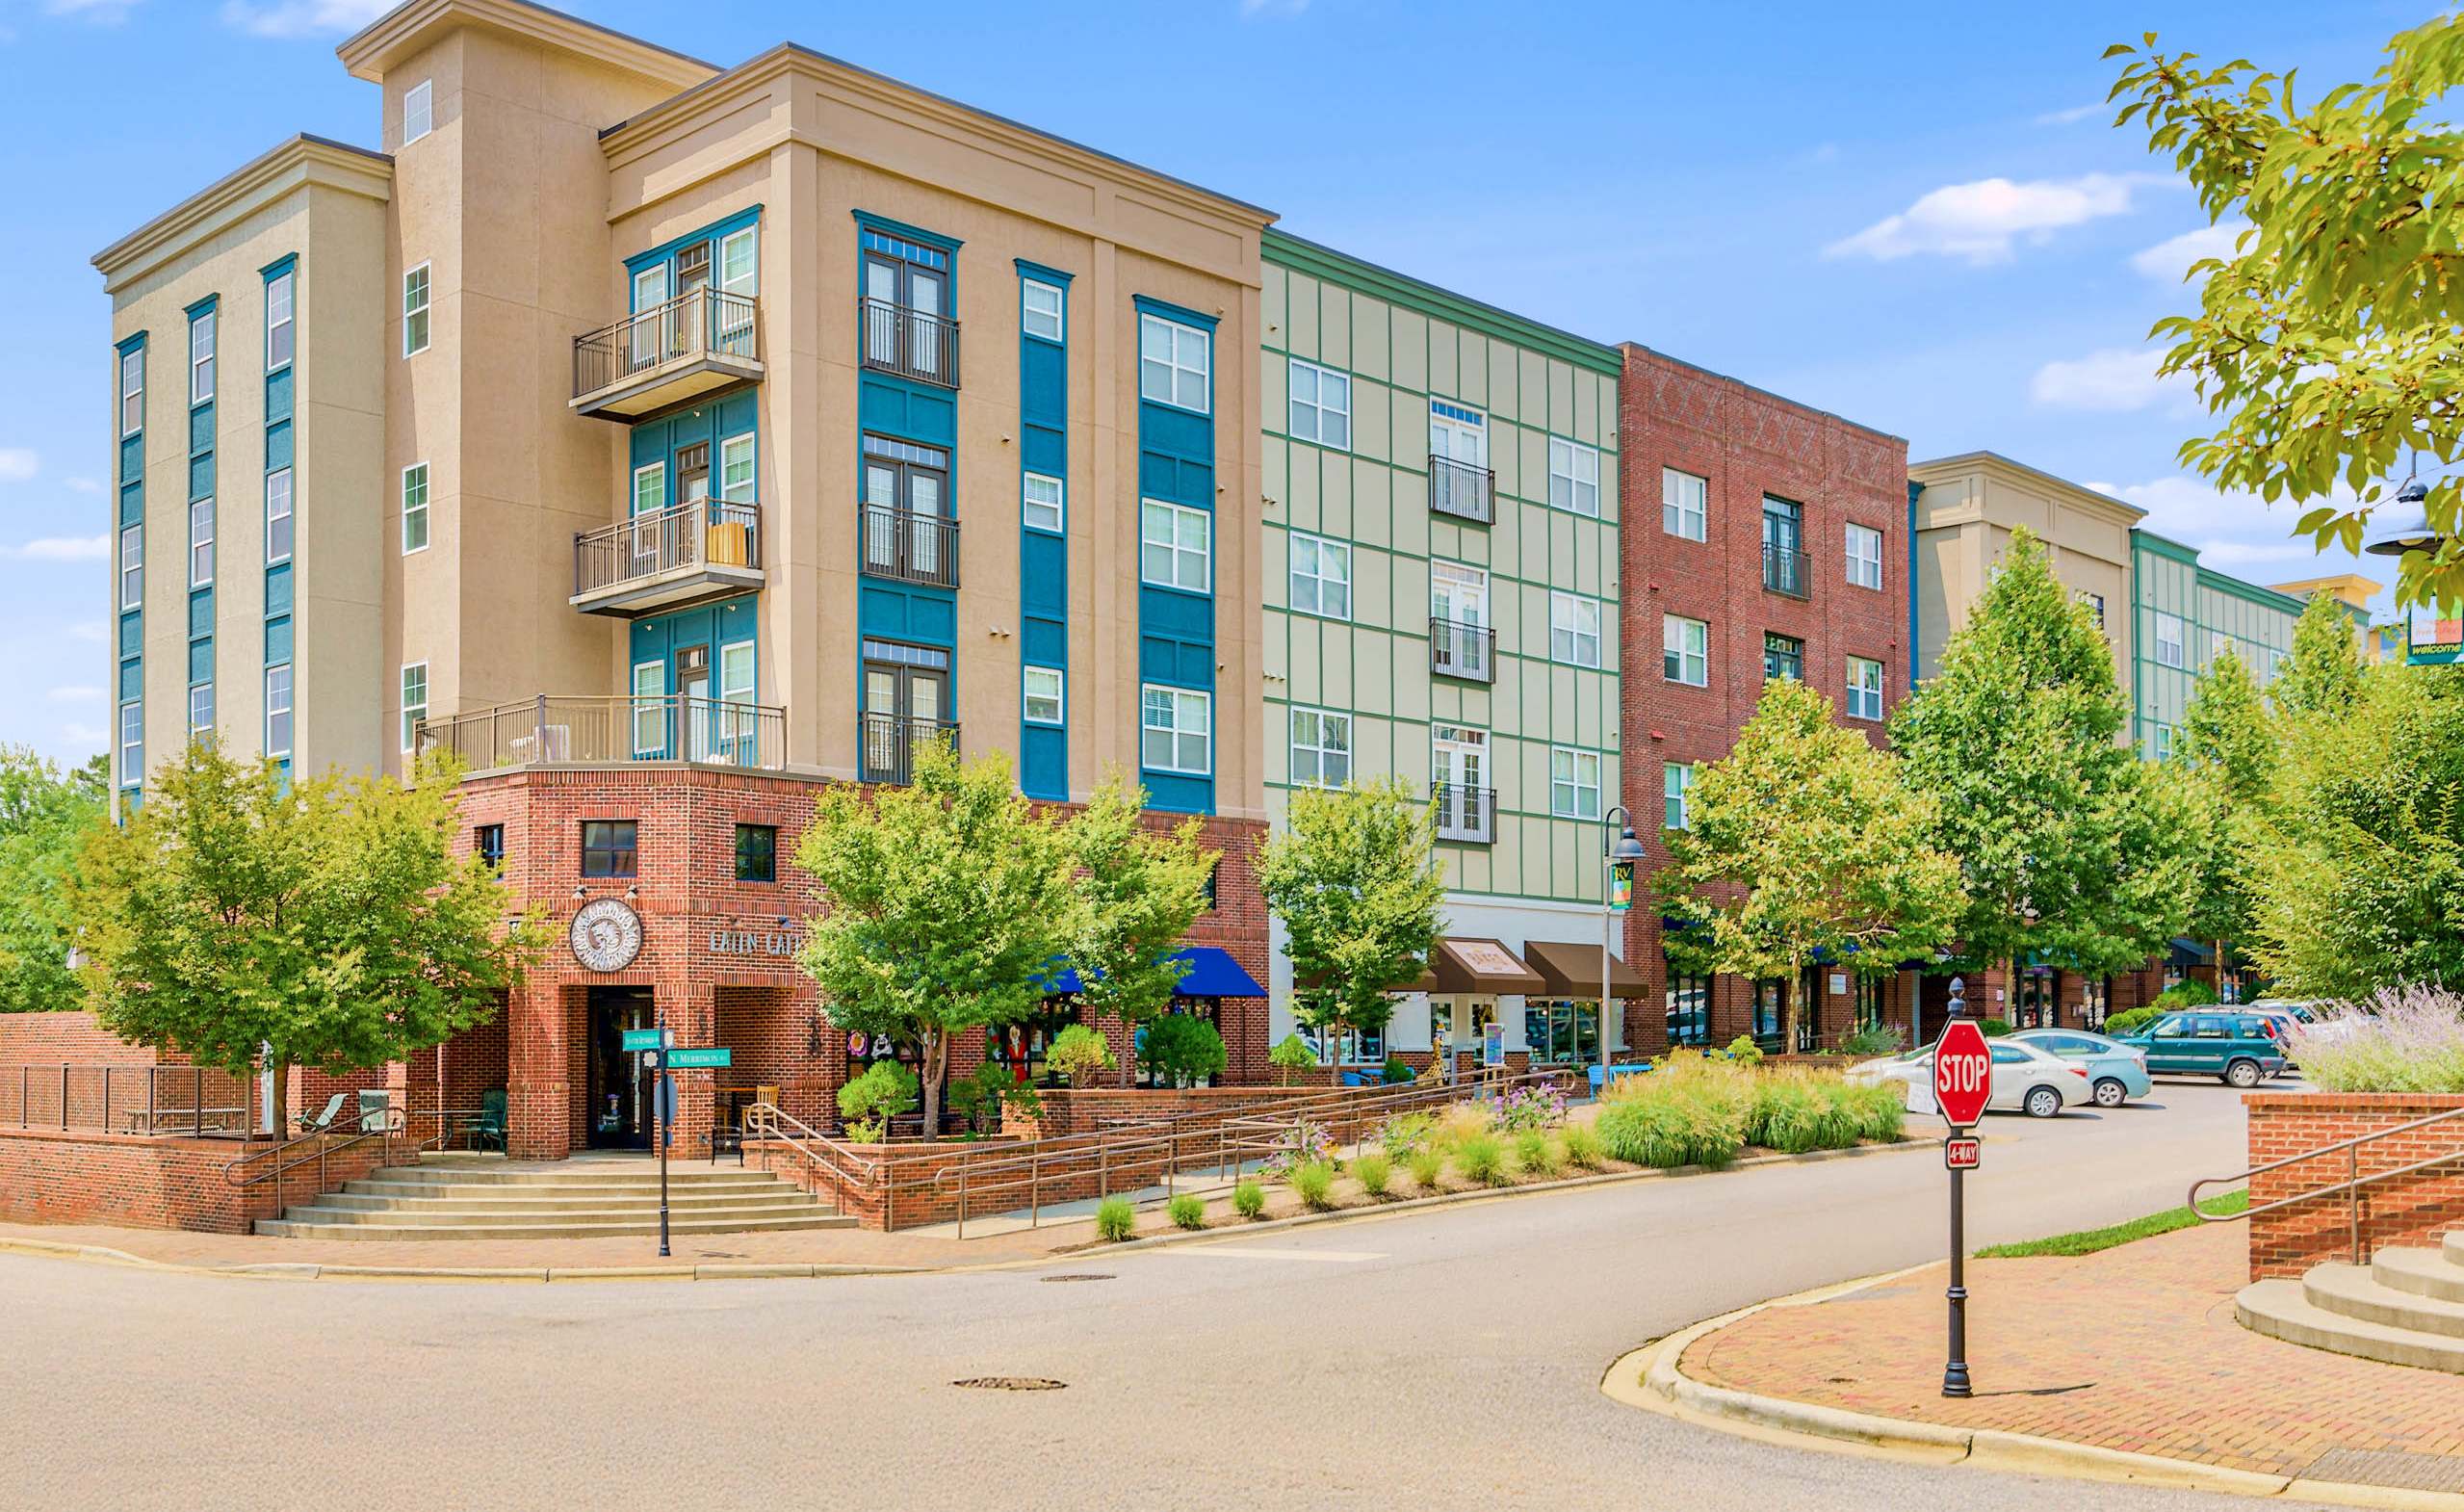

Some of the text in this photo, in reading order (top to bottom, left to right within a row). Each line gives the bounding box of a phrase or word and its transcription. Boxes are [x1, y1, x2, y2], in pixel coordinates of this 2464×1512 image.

[2412, 643, 2461, 655] welcome
[1616, 867, 1631, 880] RV
[669, 1054, 676, 1064] N
[1939, 1054, 1988, 1092] STOP
[1950, 1146, 1977, 1161] 4-WAY
